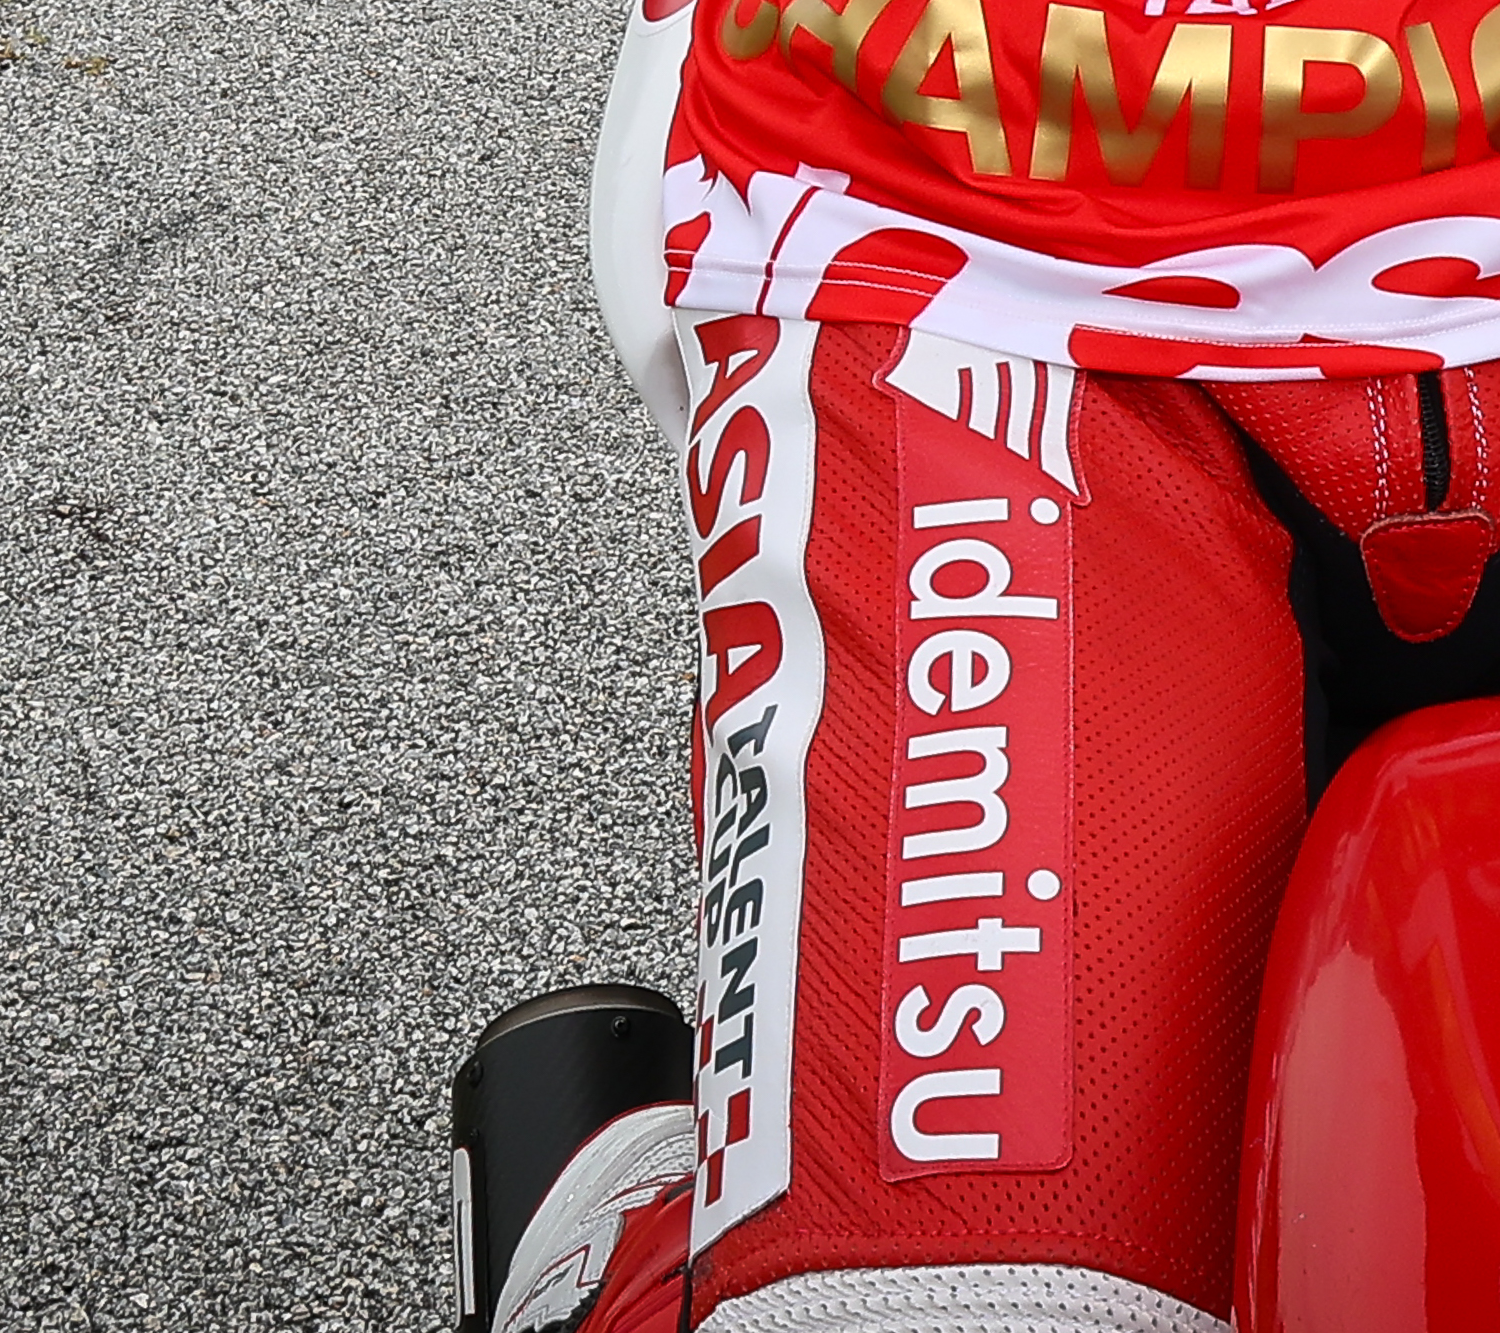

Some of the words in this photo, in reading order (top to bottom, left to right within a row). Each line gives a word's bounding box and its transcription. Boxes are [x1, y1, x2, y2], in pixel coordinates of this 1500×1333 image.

[687, 313, 786, 746] ASIA
[716, 703, 779, 1081] TALENT
[889, 497, 1063, 1164] idemitsu
